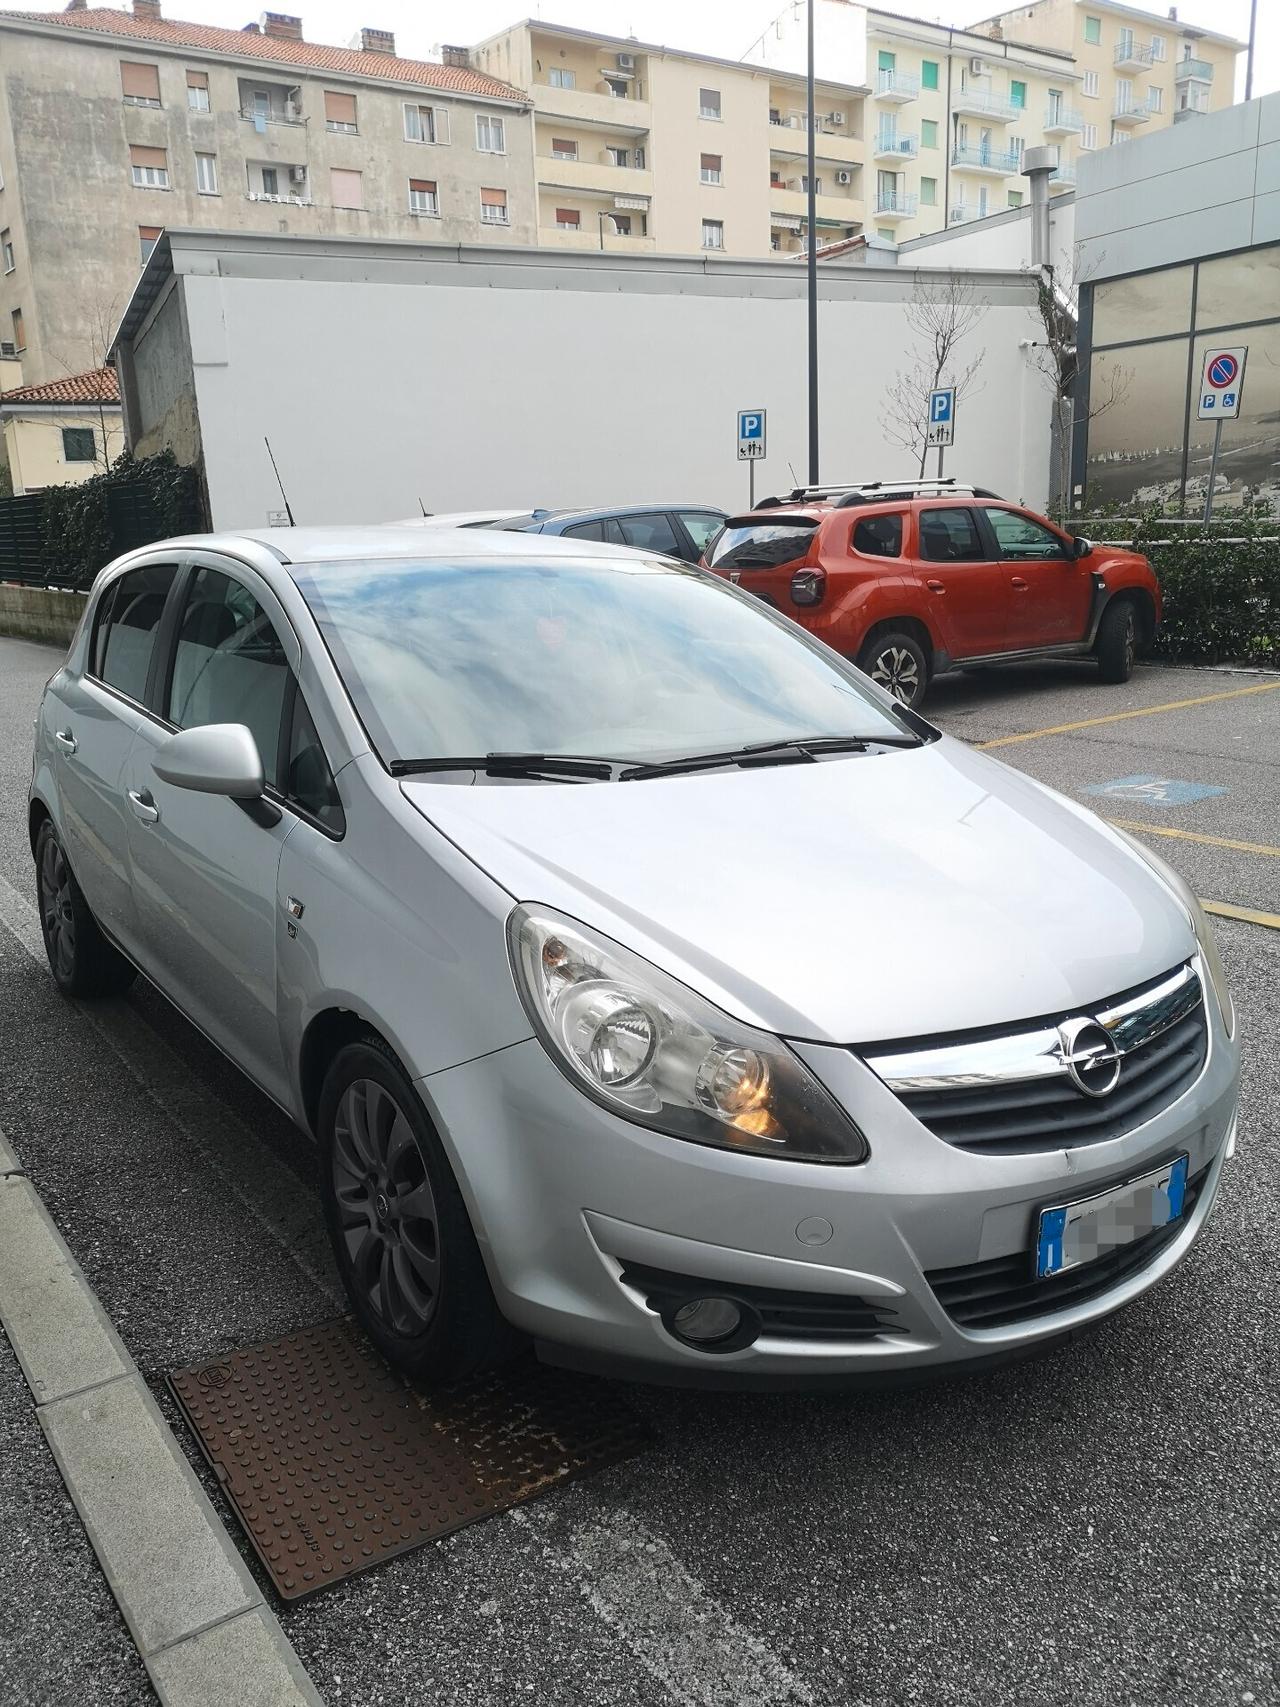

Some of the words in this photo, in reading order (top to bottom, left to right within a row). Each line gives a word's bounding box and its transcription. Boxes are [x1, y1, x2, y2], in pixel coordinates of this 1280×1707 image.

[934, 396, 947, 419] P
[1205, 396, 1214, 407] P
[744, 417, 758, 436] P
